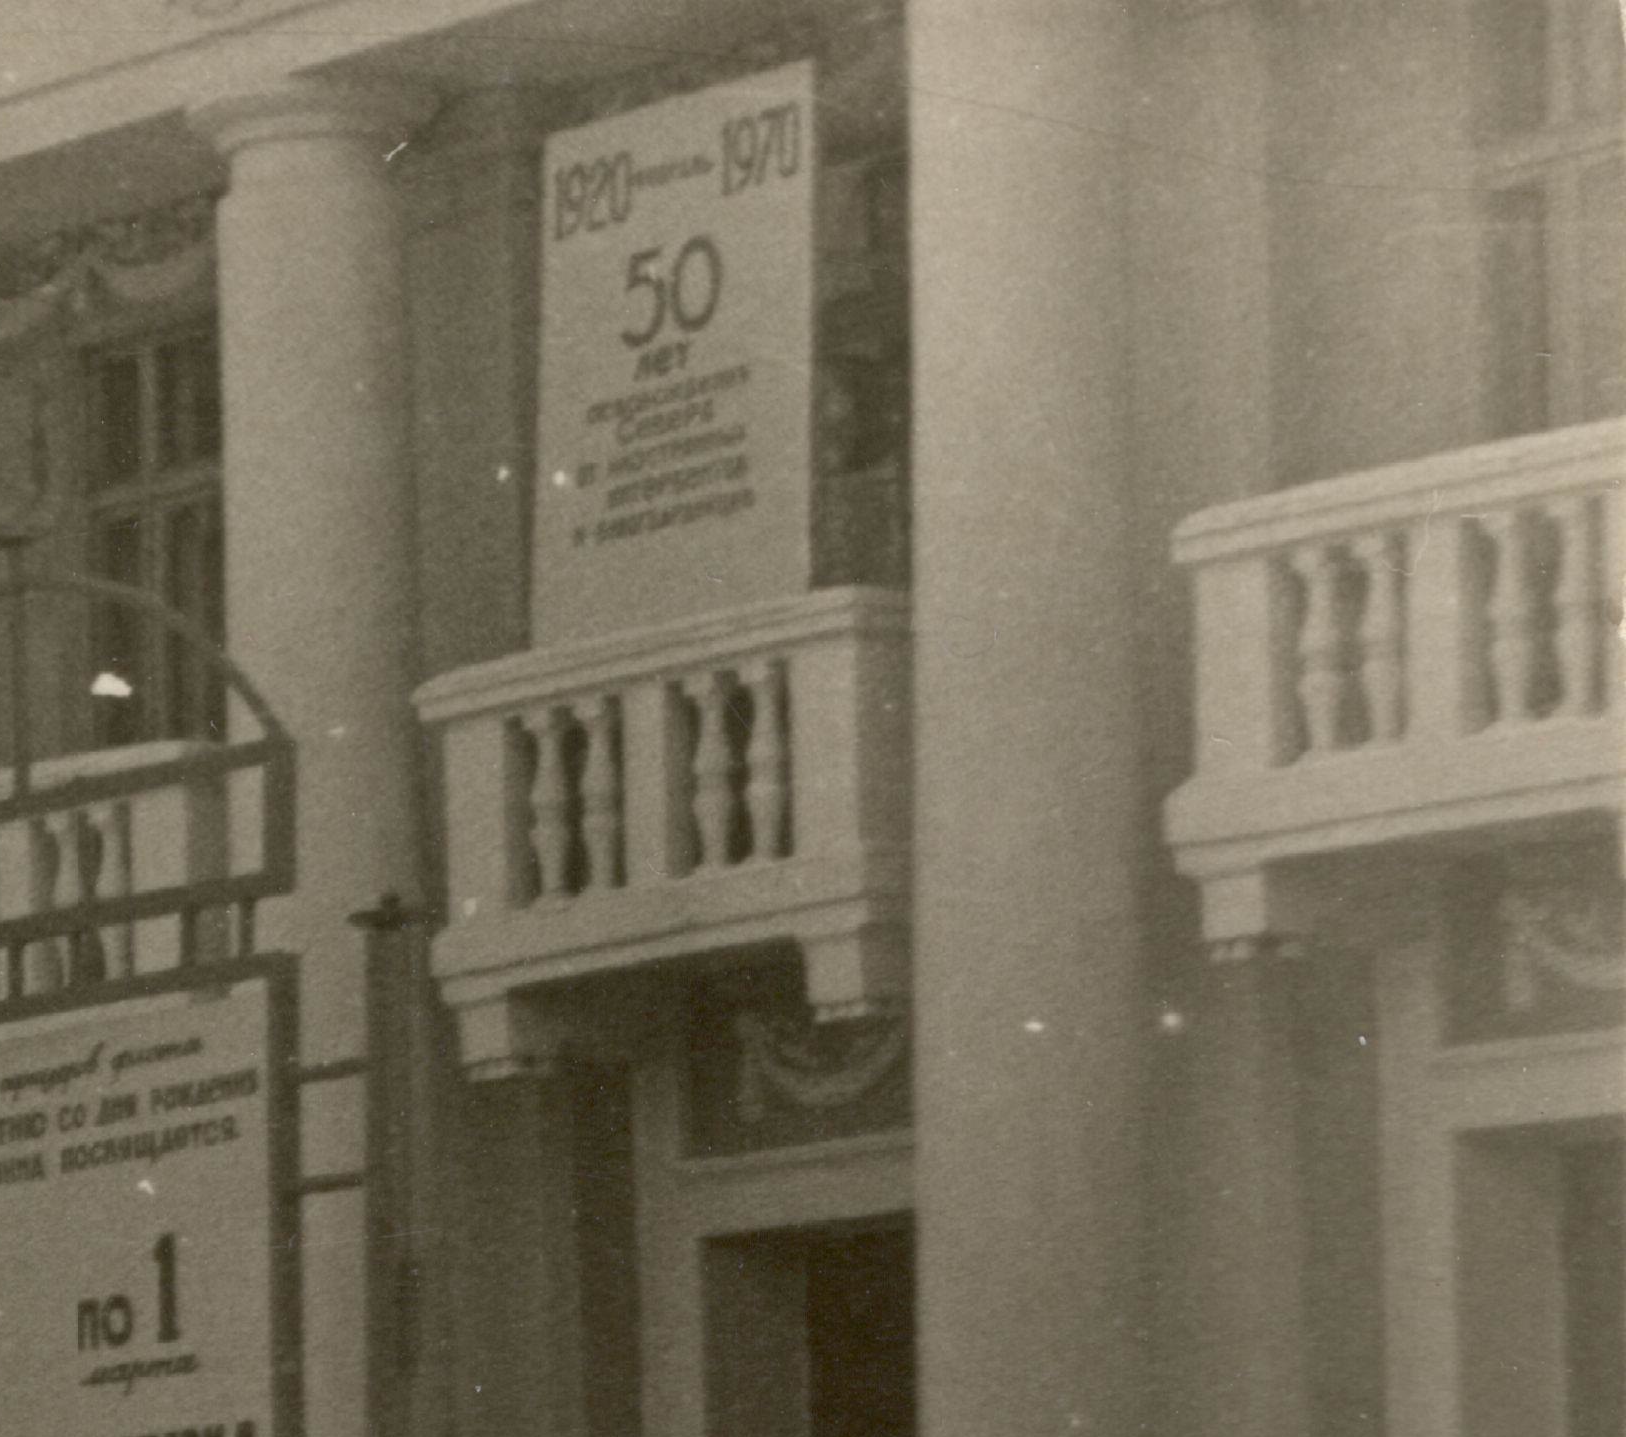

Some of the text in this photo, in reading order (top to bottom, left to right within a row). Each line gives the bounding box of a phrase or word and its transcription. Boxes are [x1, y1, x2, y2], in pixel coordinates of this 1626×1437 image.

[722, 102, 800, 196] 1970
[621, 235, 722, 348] 50
[153, 1231, 181, 1344] 1
